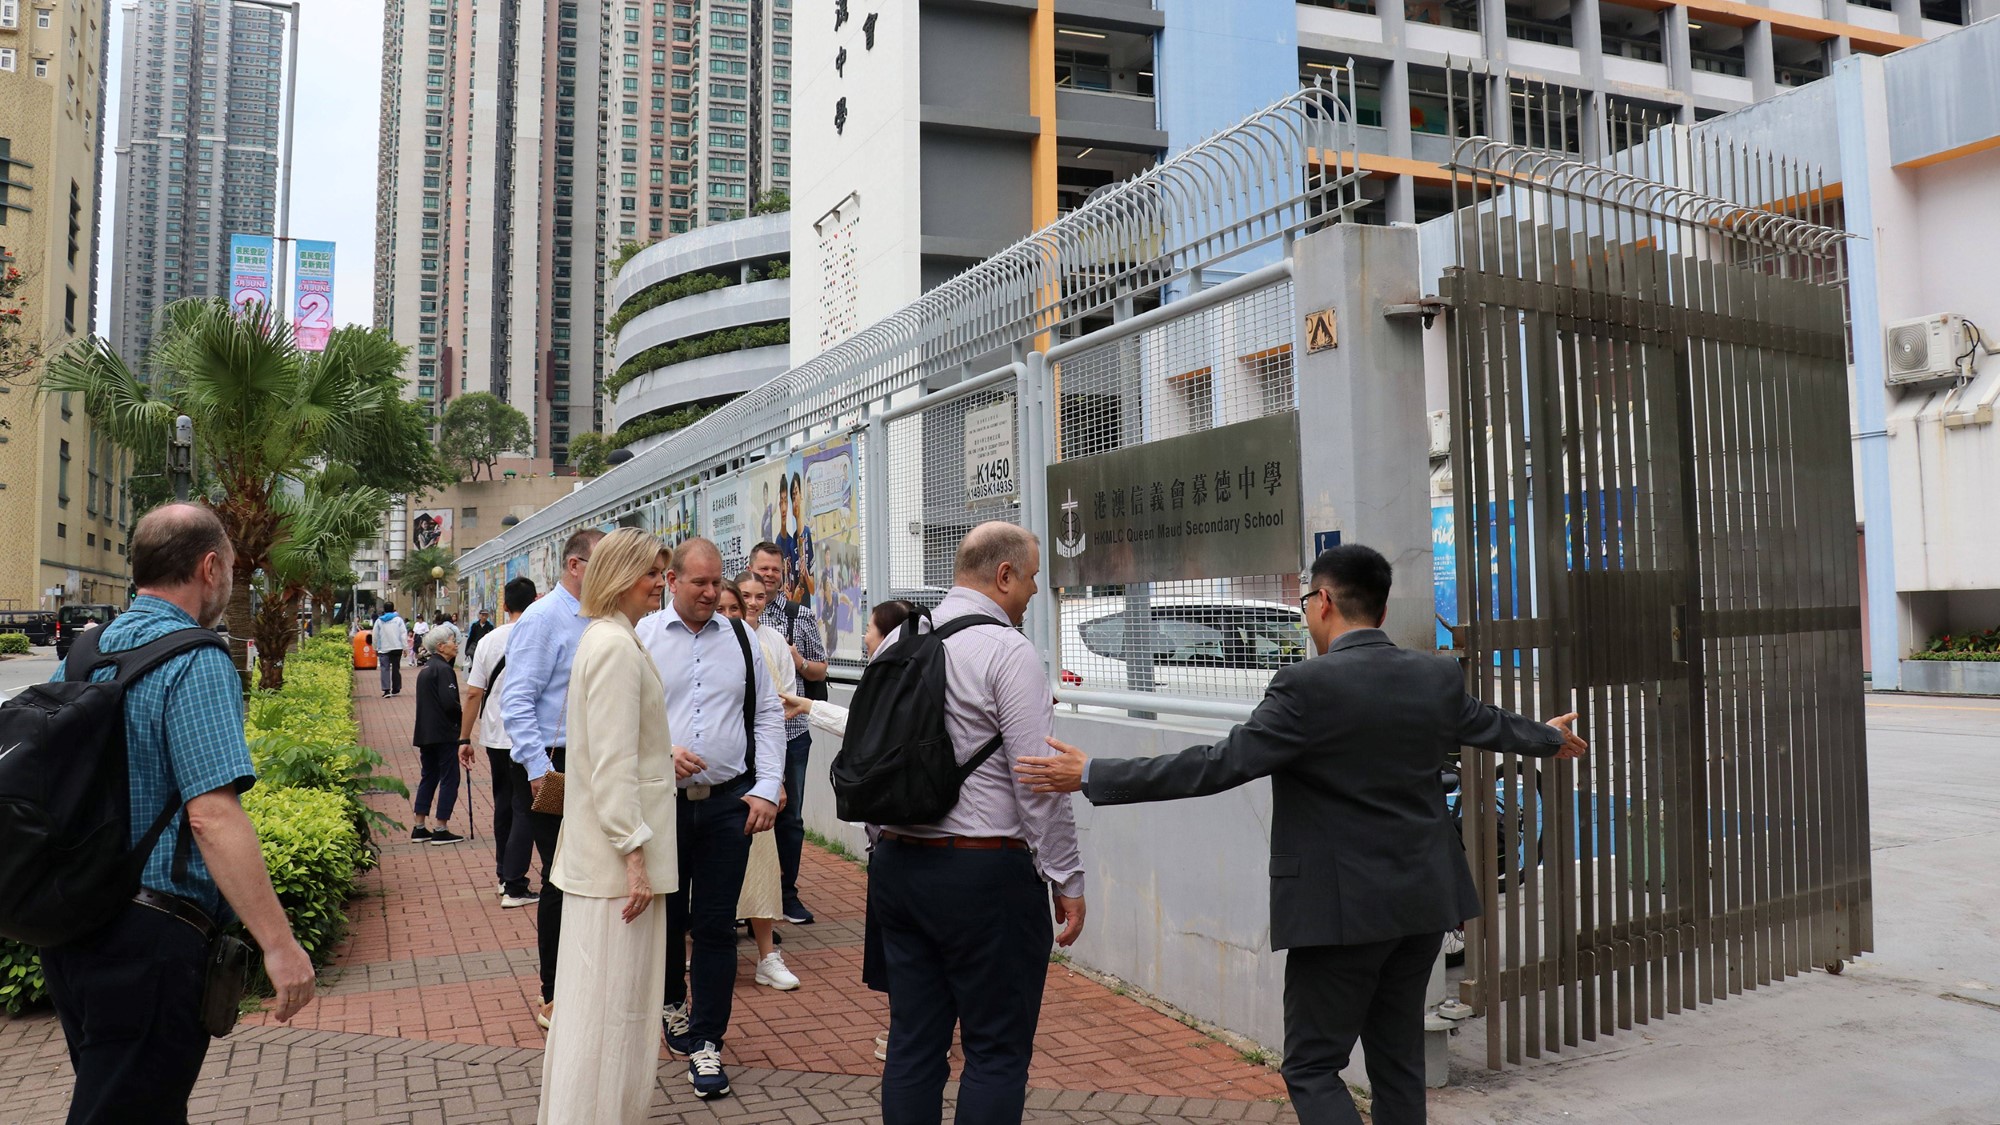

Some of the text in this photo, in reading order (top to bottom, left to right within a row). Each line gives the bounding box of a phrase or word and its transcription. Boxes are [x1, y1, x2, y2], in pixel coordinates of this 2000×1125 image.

[299, 292, 330, 330] 2
[976, 457, 1010, 485] K1450
[1094, 461, 1282, 521] 港澳信義會慕德中學
[1094, 508, 1284, 546] HKMLC Queen Maud Secondary School
